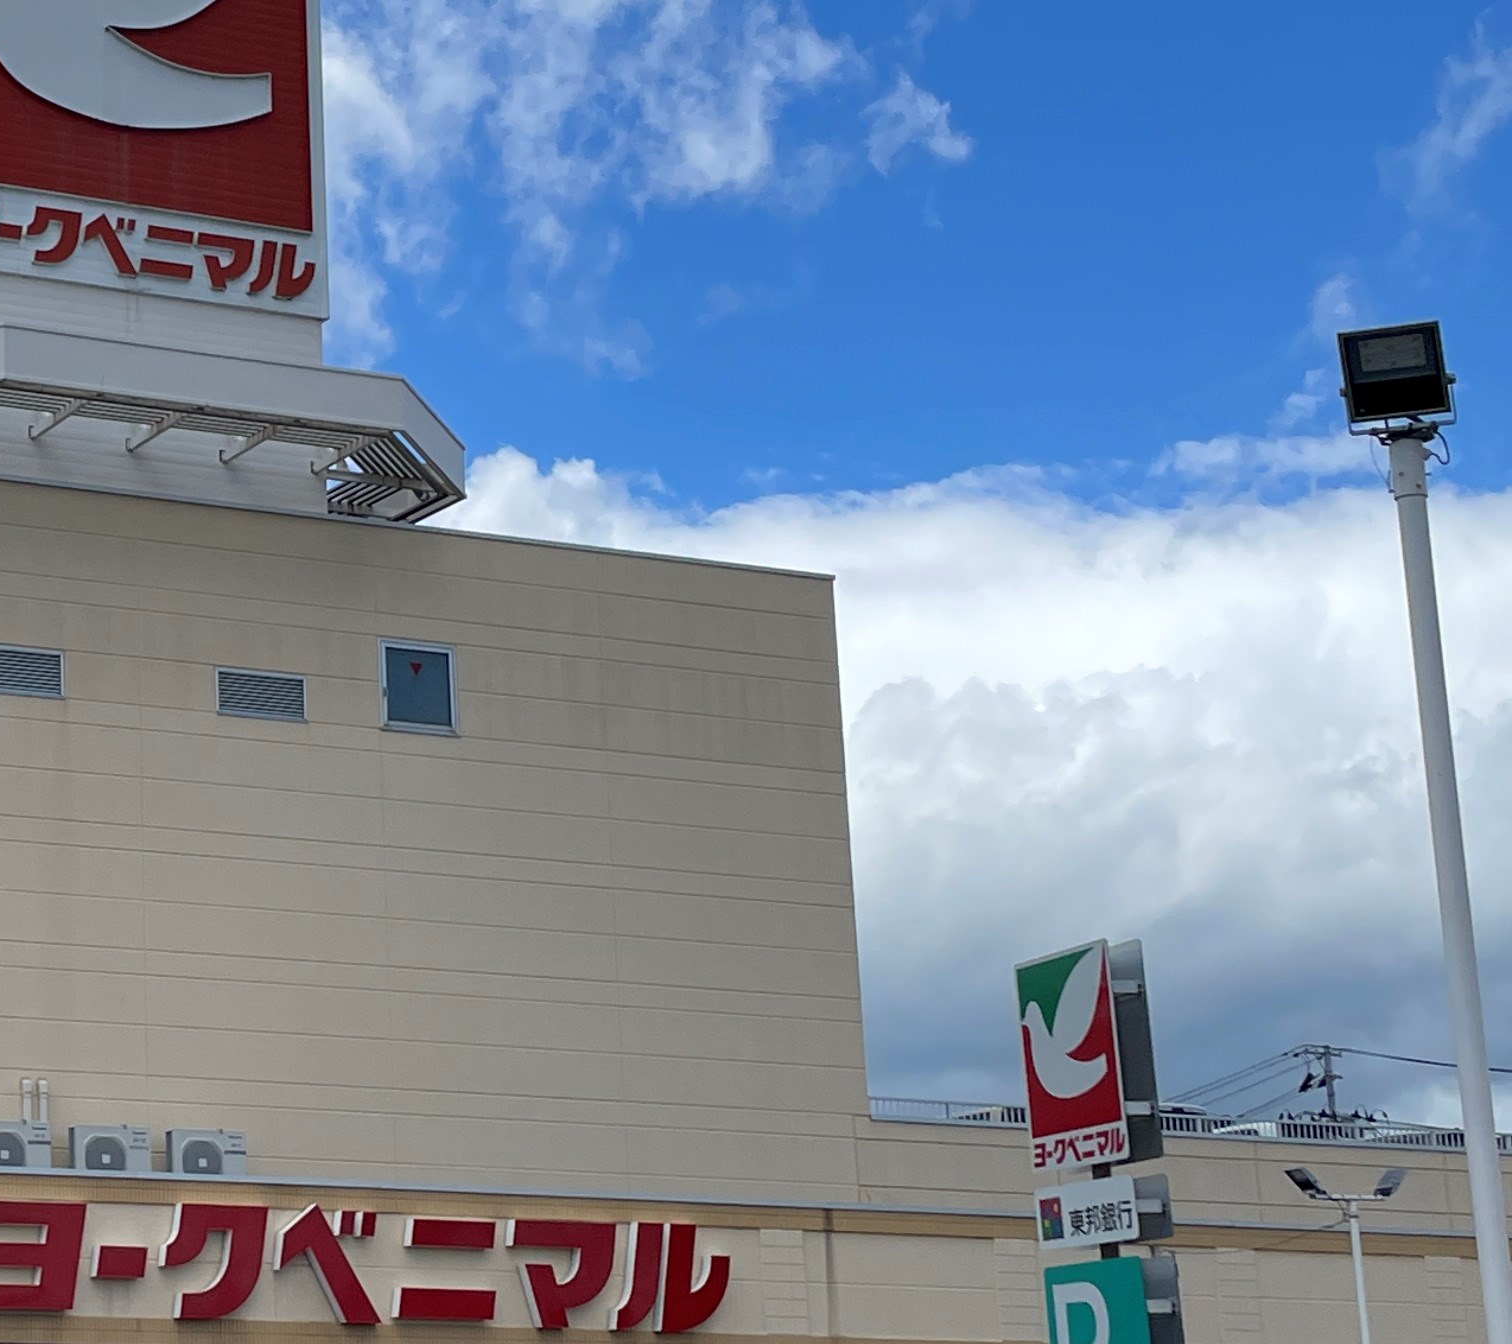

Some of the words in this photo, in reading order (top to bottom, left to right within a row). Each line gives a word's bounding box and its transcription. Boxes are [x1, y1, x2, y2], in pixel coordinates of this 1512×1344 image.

[1033, 1127, 1126, 1168] ヨークベニマル
[1068, 1199, 1133, 1237] 東邦銀行
